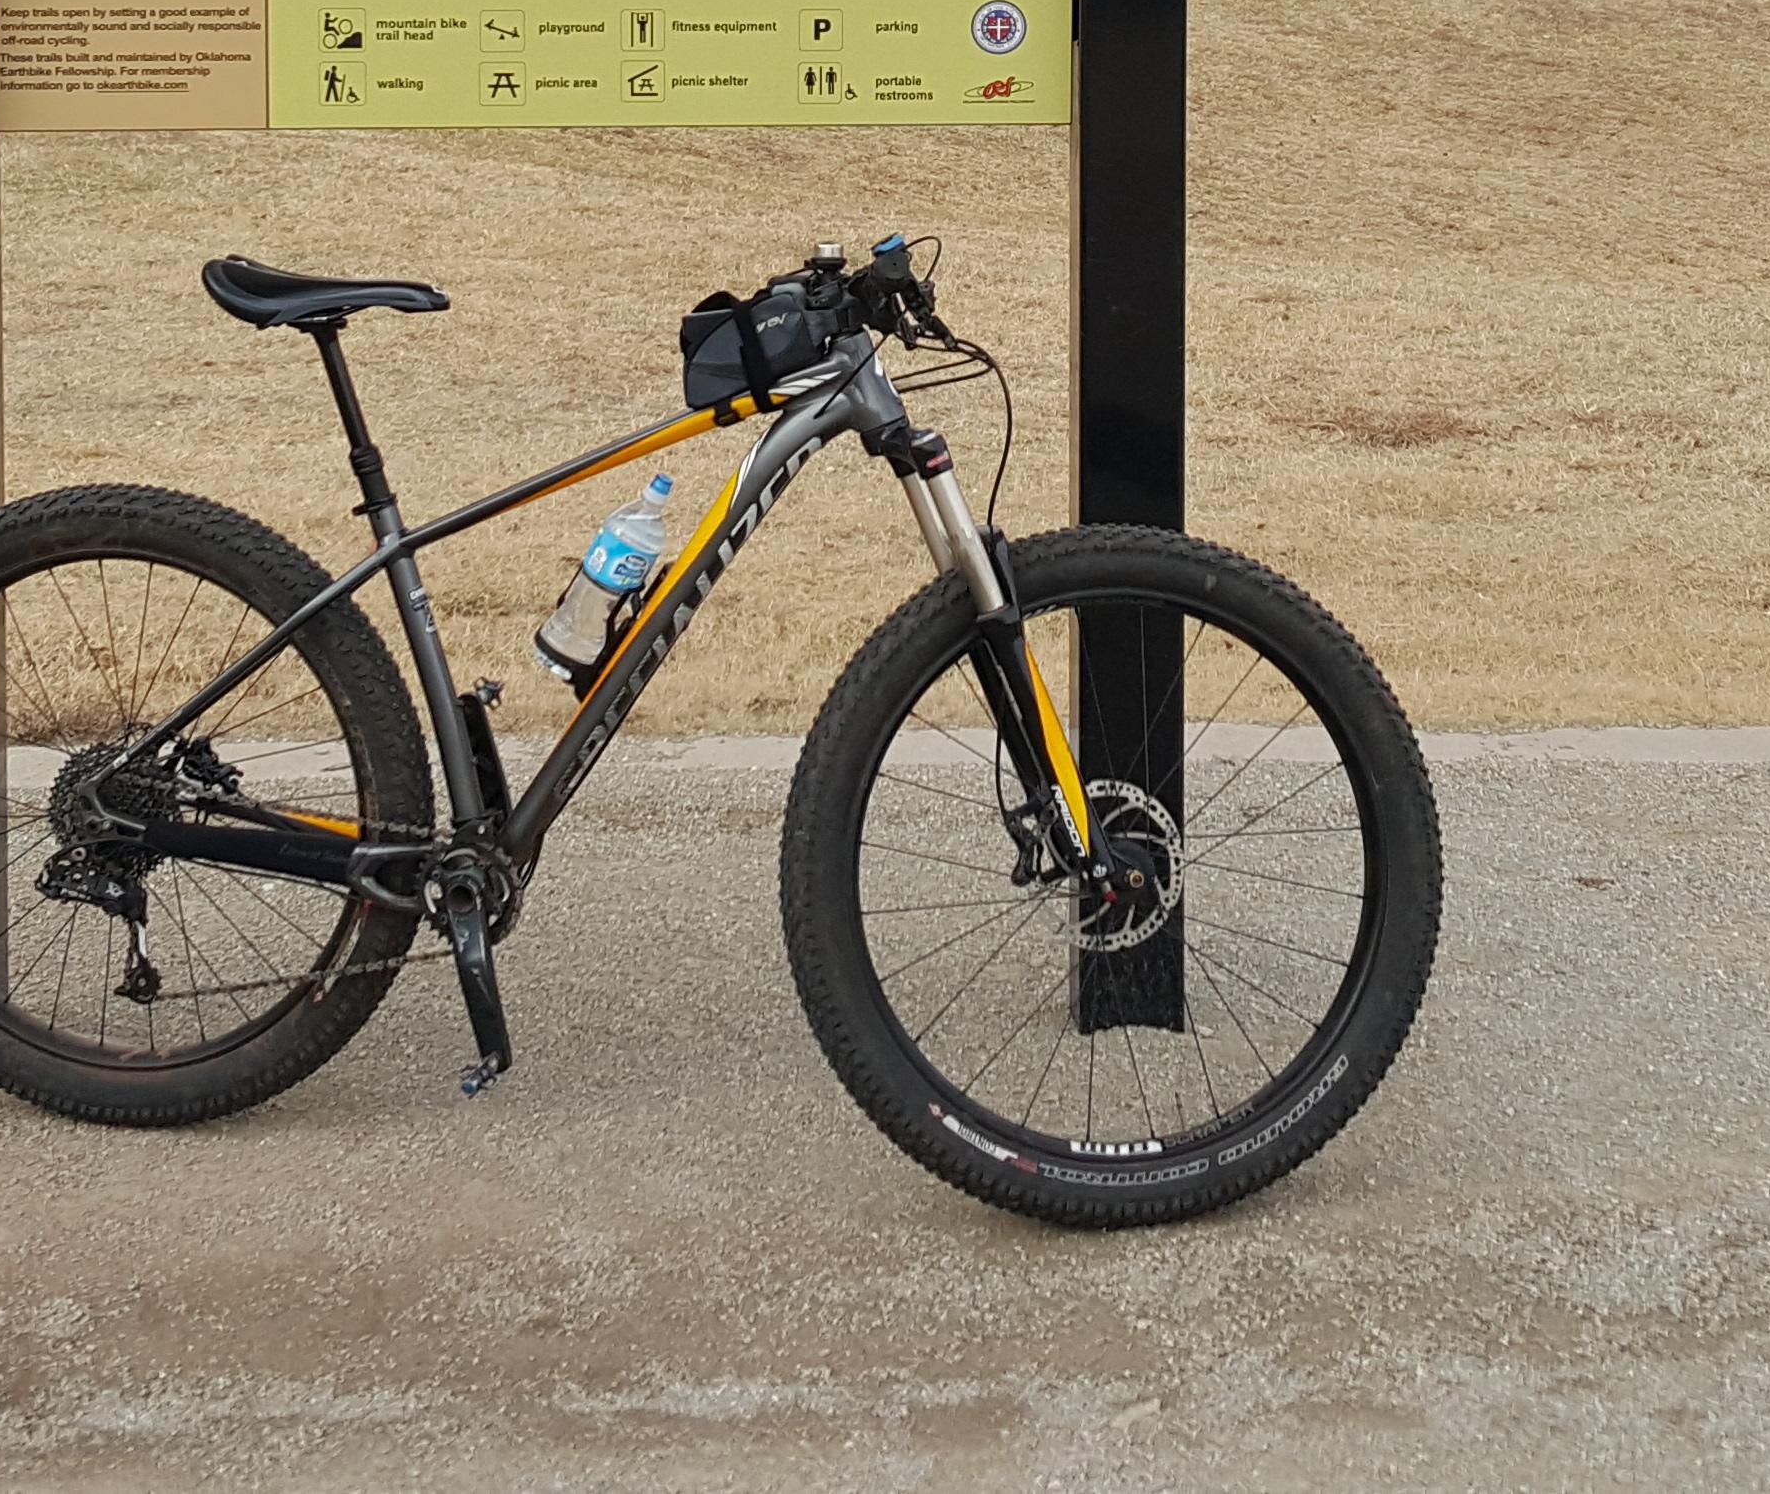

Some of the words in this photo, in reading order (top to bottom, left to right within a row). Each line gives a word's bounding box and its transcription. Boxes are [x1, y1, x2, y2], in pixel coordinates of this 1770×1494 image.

[376, 18, 436, 29] mountain
[440, 18, 467, 29] bike
[538, 22, 605, 35] playground
[671, 21, 711, 32] fitness
[714, 21, 777, 34] equipment
[875, 21, 919, 34] parking
[376, 31, 399, 41] trail
[404, 31, 434, 41] head
[813, 19, 831, 41] P
[0, 66, 52, 76] Earthbike
[54, 66, 117, 78] Fellowship.
[119, 66, 138, 76] For
[140, 66, 210, 78] membership
[0, 80, 63, 90] information
[65, 83, 80, 92] go
[82, 80, 94, 90] to
[96, 80, 188, 90] okearthbike.com
[377, 78, 424, 91] walking
[535, 78, 571, 90] picnic
[573, 79, 598, 88] area
[671, 76, 705, 88] picnic
[709, 76, 748, 87] shelter
[875, 76, 922, 88] portable
[875, 91, 933, 101] restrooms
[1051, 784, 1086, 858] RAIDON
